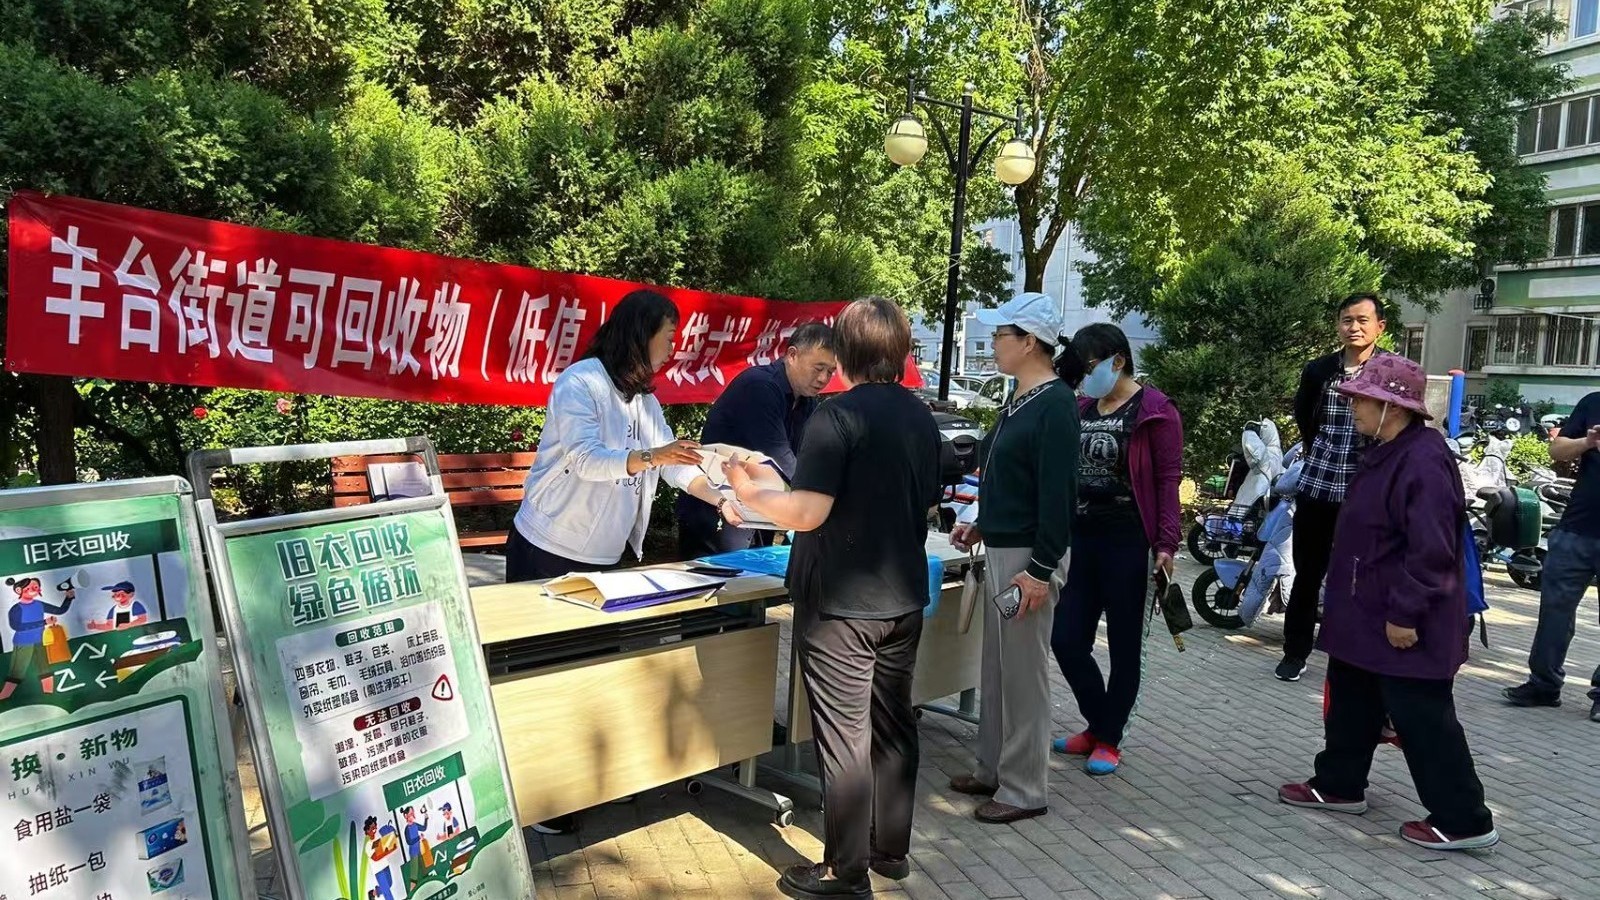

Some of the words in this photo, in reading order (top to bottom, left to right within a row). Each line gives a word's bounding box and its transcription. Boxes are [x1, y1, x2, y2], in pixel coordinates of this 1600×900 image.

[23, 530, 131, 565] 旧衣回收
[276, 520, 414, 580] 旧衣回收
[288, 559, 422, 626] 绿色循环
[347, 621, 396, 644] 回收范围
[364, 701, 411, 727] 无法回收
[68, 766, 97, 782] XIN
[108, 756, 130, 769] WU
[402, 765, 446, 797] 旧衣回收
[14, 792, 112, 841] 食用盐一袋
[28, 851, 106, 896] 抽纸一包
